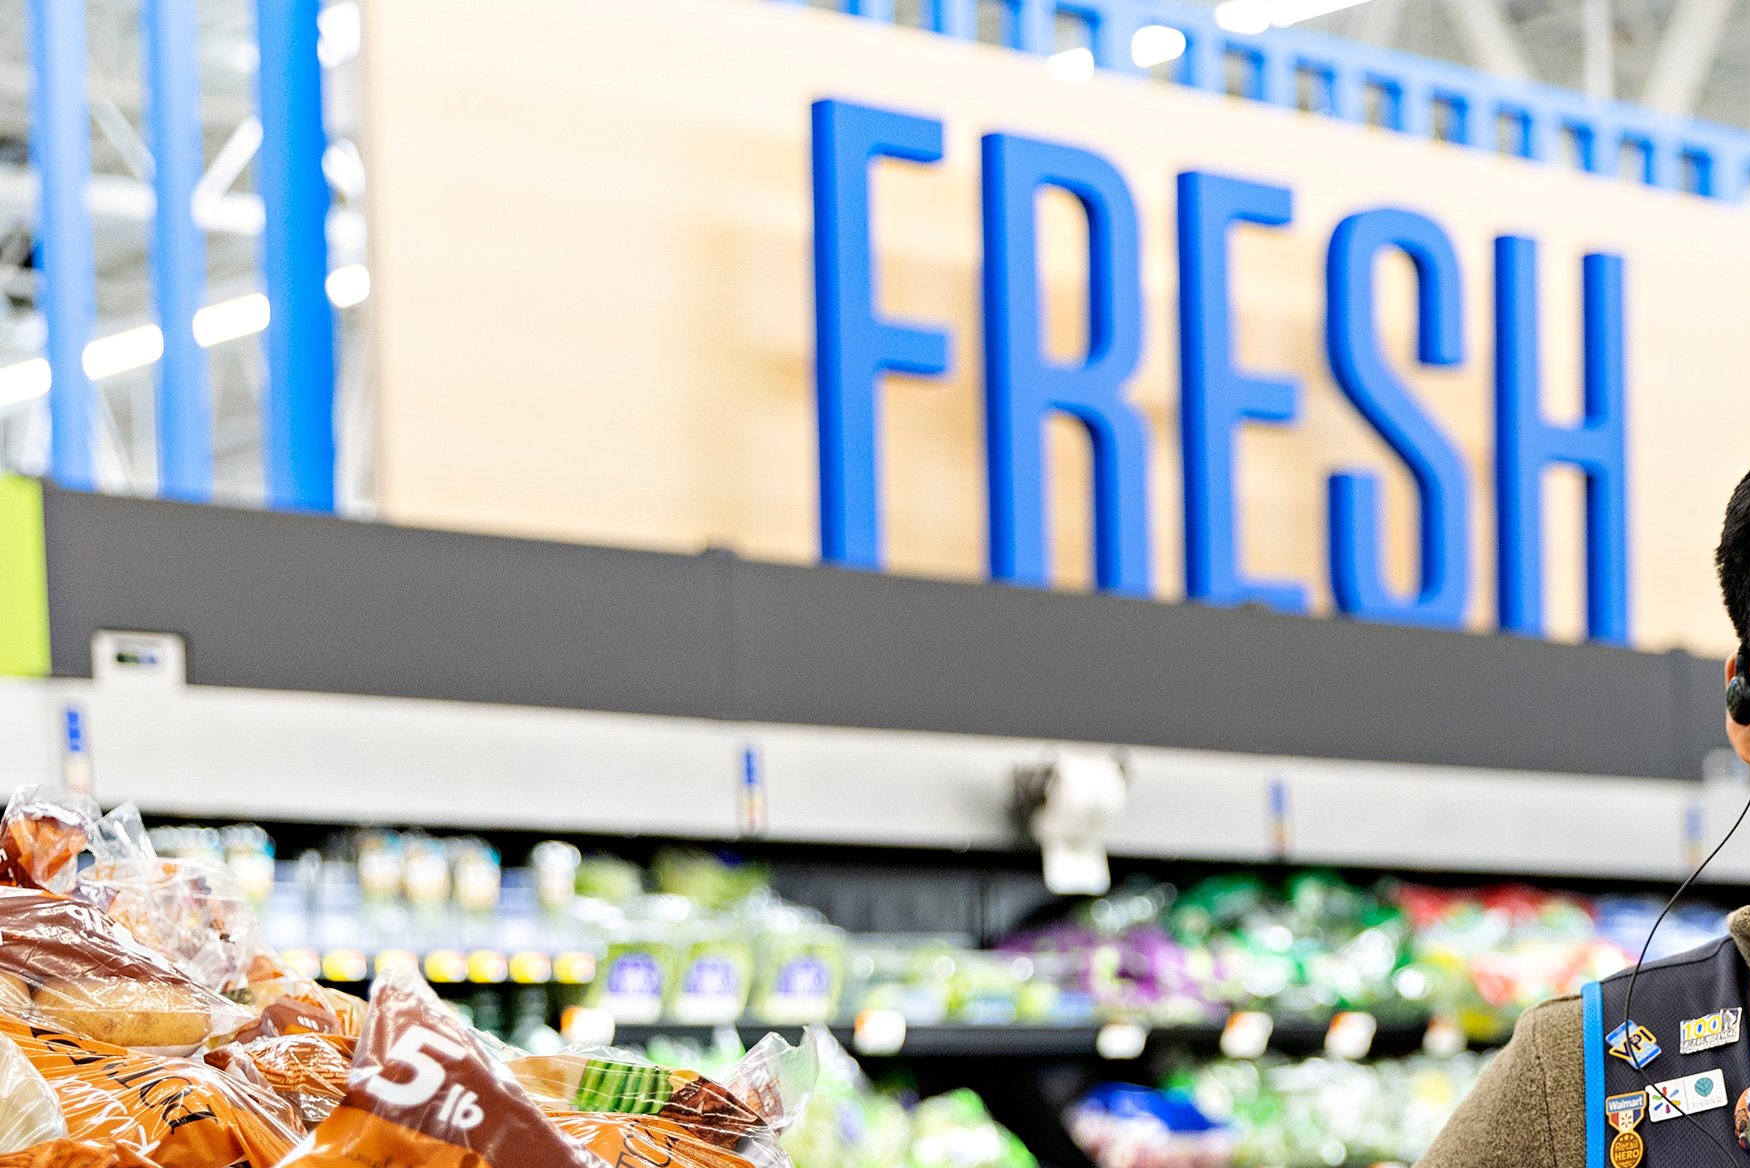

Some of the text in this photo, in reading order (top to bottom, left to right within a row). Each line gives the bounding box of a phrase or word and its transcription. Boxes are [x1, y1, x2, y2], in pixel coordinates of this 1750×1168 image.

[811, 97, 1633, 647] FRESH
[1683, 1015, 1721, 1040] 100
[1611, 1028, 1654, 1058] VPI
[366, 1025, 468, 1106] 5
[437, 1083, 485, 1130] lb
[1608, 1096, 1643, 1112] Walmart
[1614, 1140, 1639, 1151] Retail
[1614, 1151, 1640, 1161] HERO
